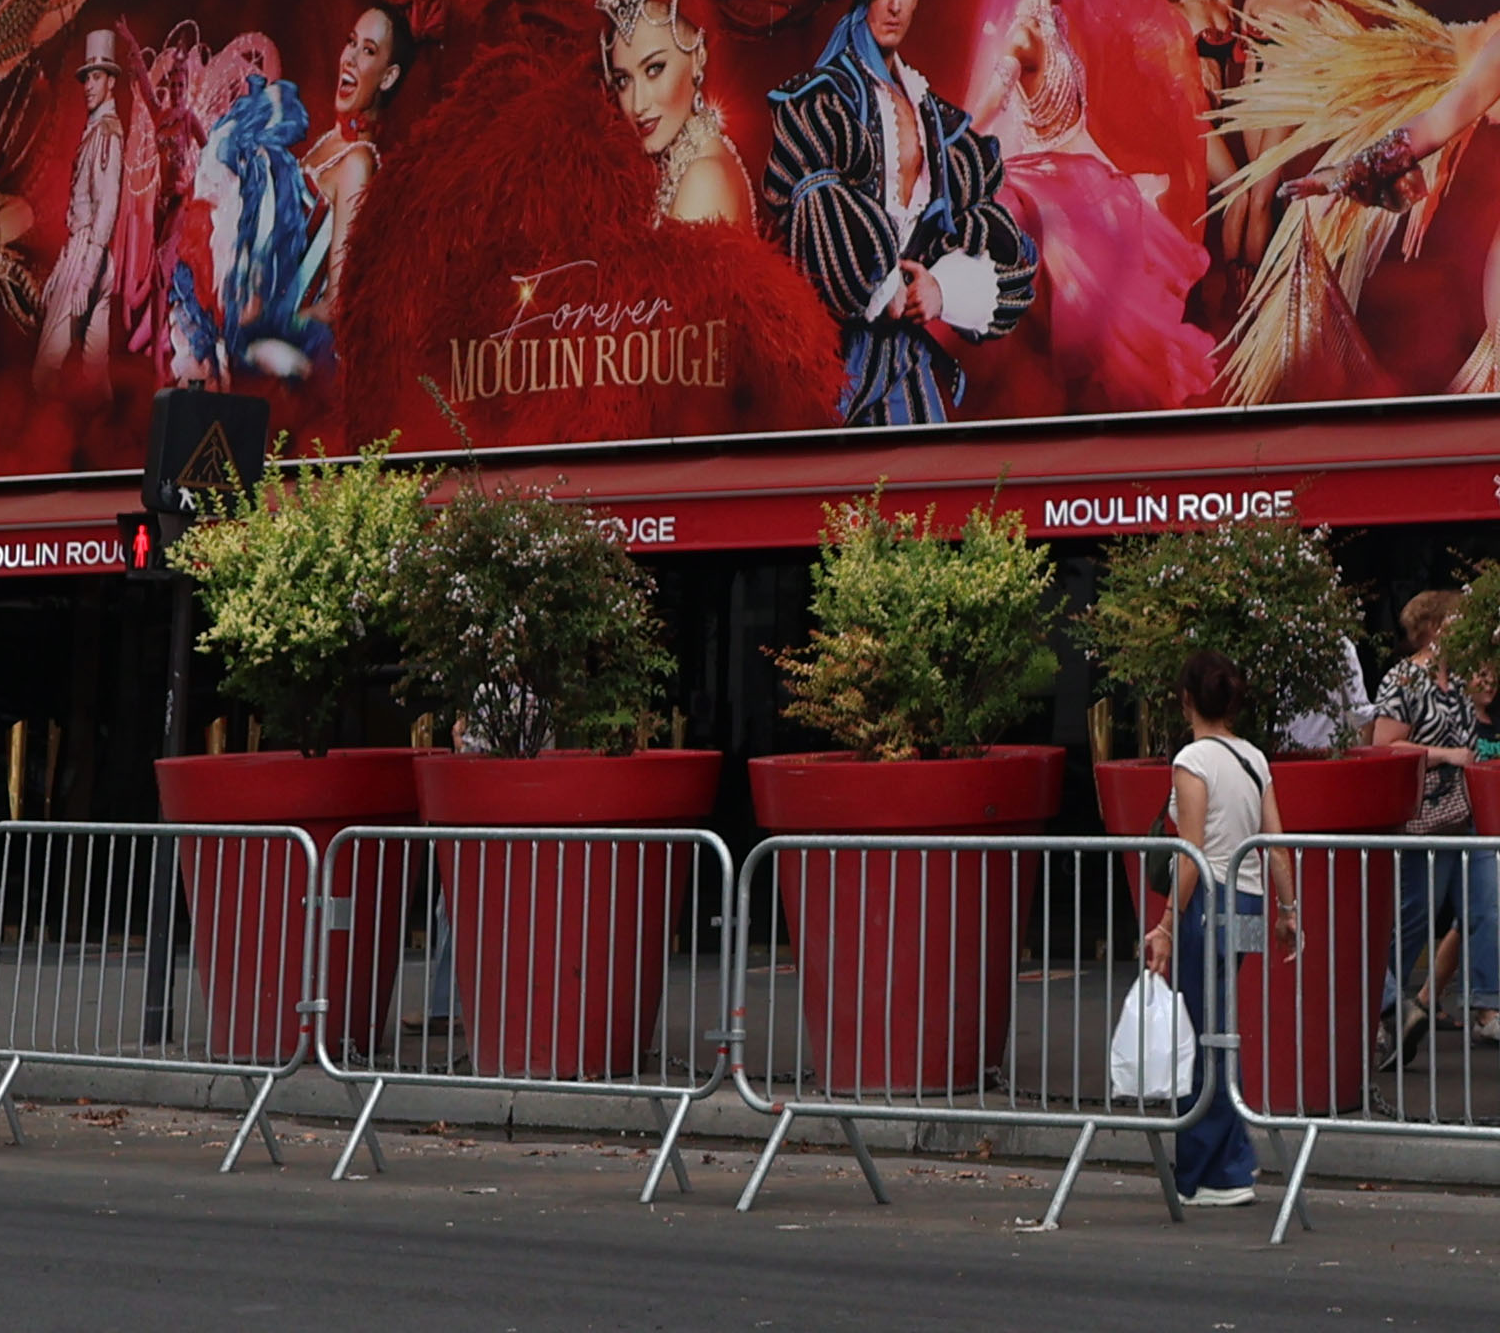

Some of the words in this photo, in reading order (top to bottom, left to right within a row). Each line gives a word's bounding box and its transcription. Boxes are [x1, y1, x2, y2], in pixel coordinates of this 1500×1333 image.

[491, 259, 673, 353] Forever
[450, 334, 585, 403] MOULIN
[593, 319, 726, 390] ROUGE
[1045, 493, 1169, 528] MOULIN
[1178, 489, 1294, 523] ROUGE
